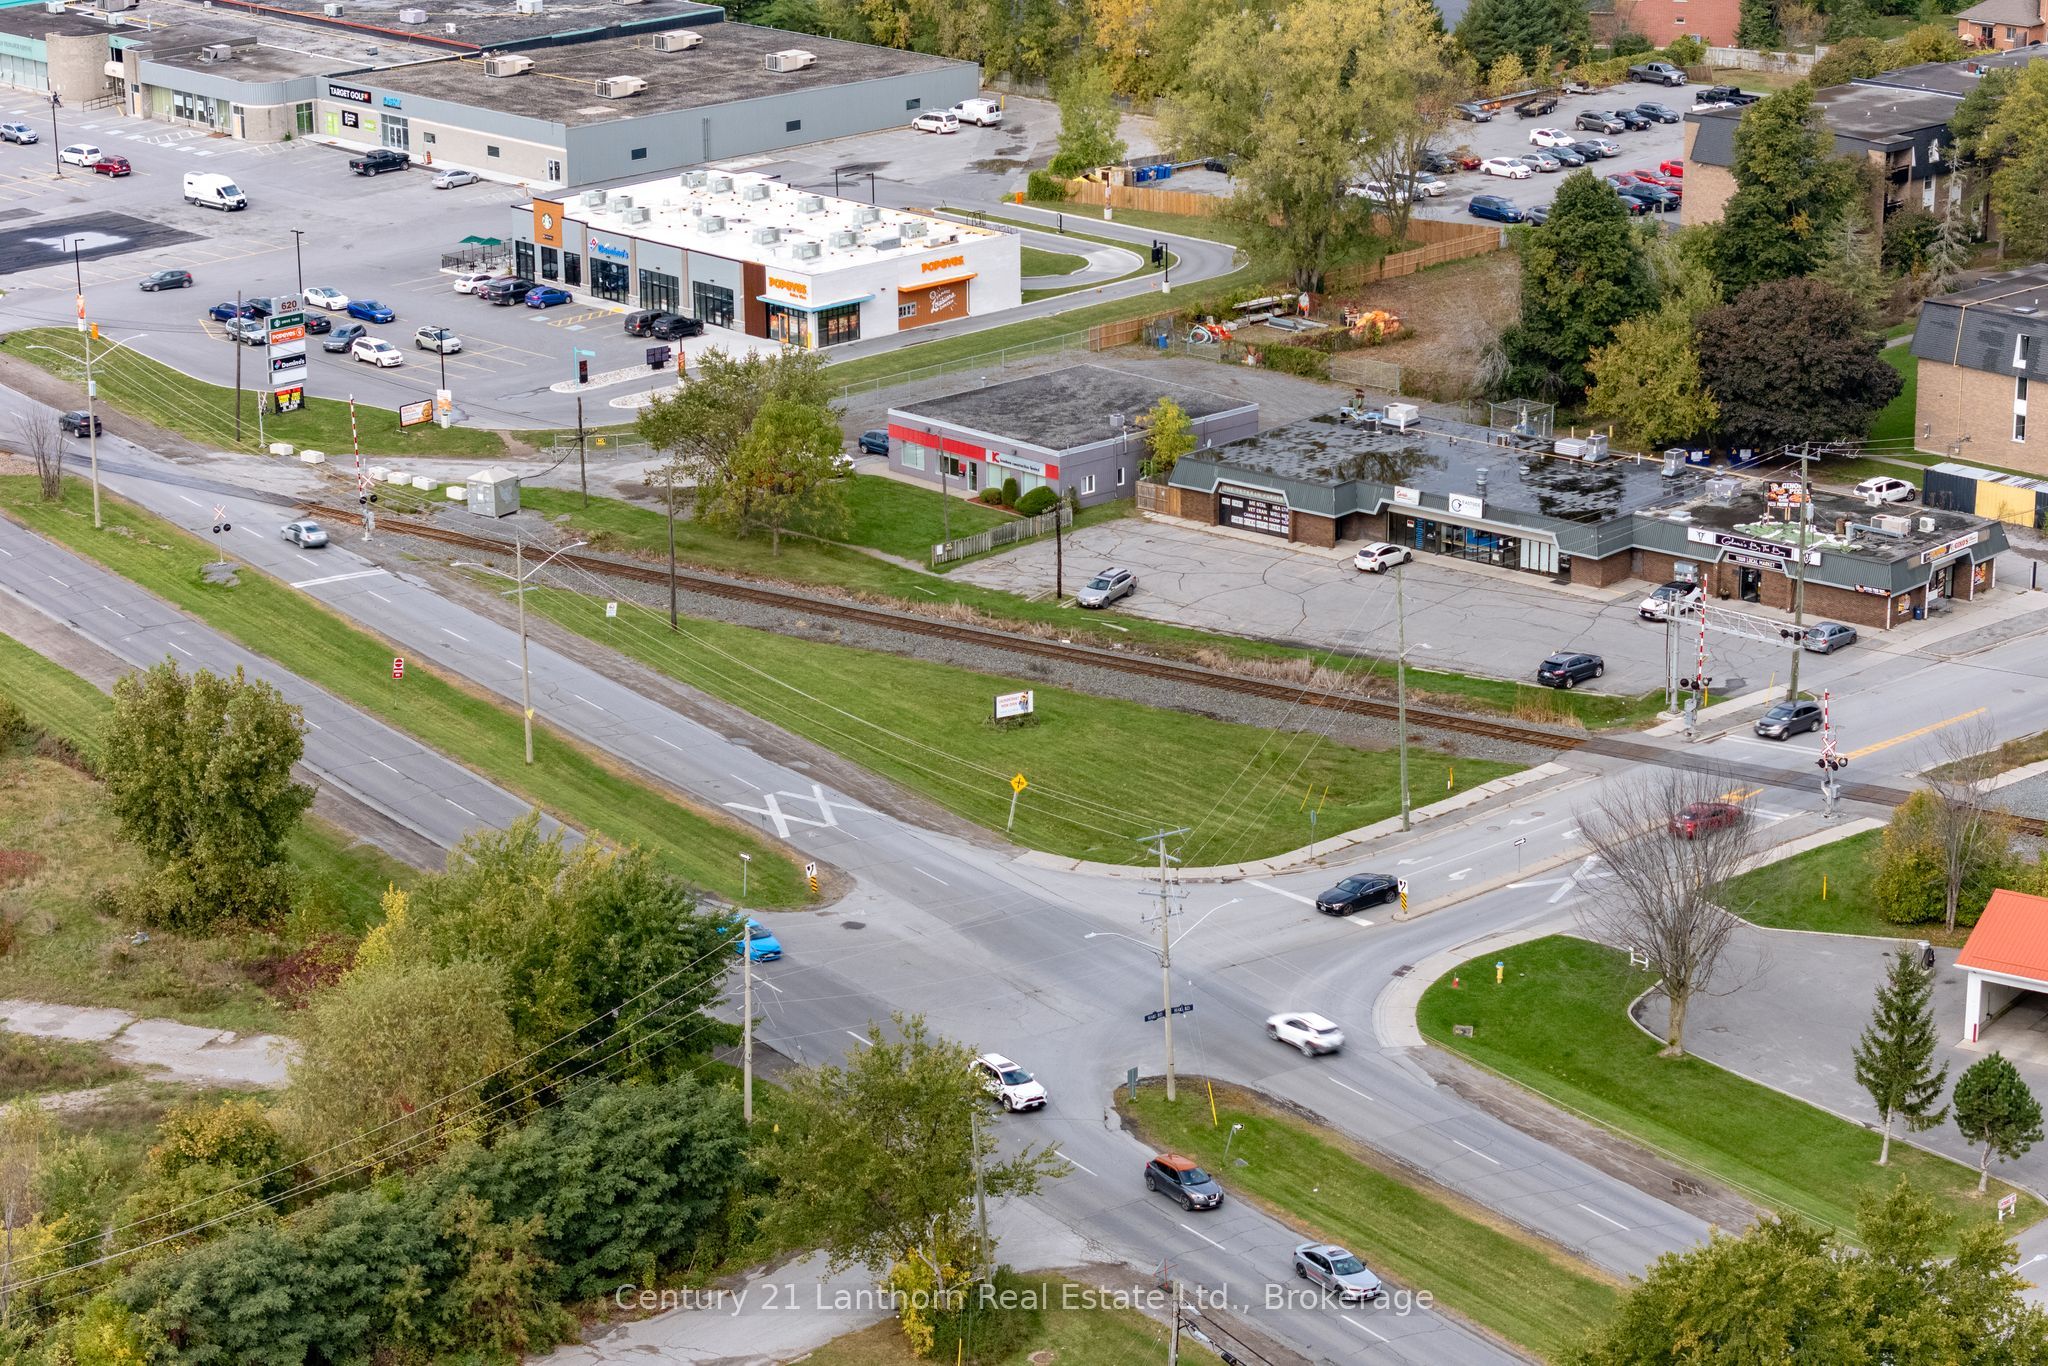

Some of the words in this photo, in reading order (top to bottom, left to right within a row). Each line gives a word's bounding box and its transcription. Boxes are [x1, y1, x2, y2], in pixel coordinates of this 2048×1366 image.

[330, 87, 350, 98] TARGET
[350, 92, 365, 101] GOLF
[598, 244, 629, 259] Domino's
[922, 256, 964, 273] POPEYES
[768, 277, 807, 294] POPEYES
[282, 300, 297, 310] 620
[272, 331, 296, 340] POPEYES
[282, 358, 305, 368] Domino's
[1748, 542, 1760, 552] By
[1759, 559, 1775, 568] MARKET
